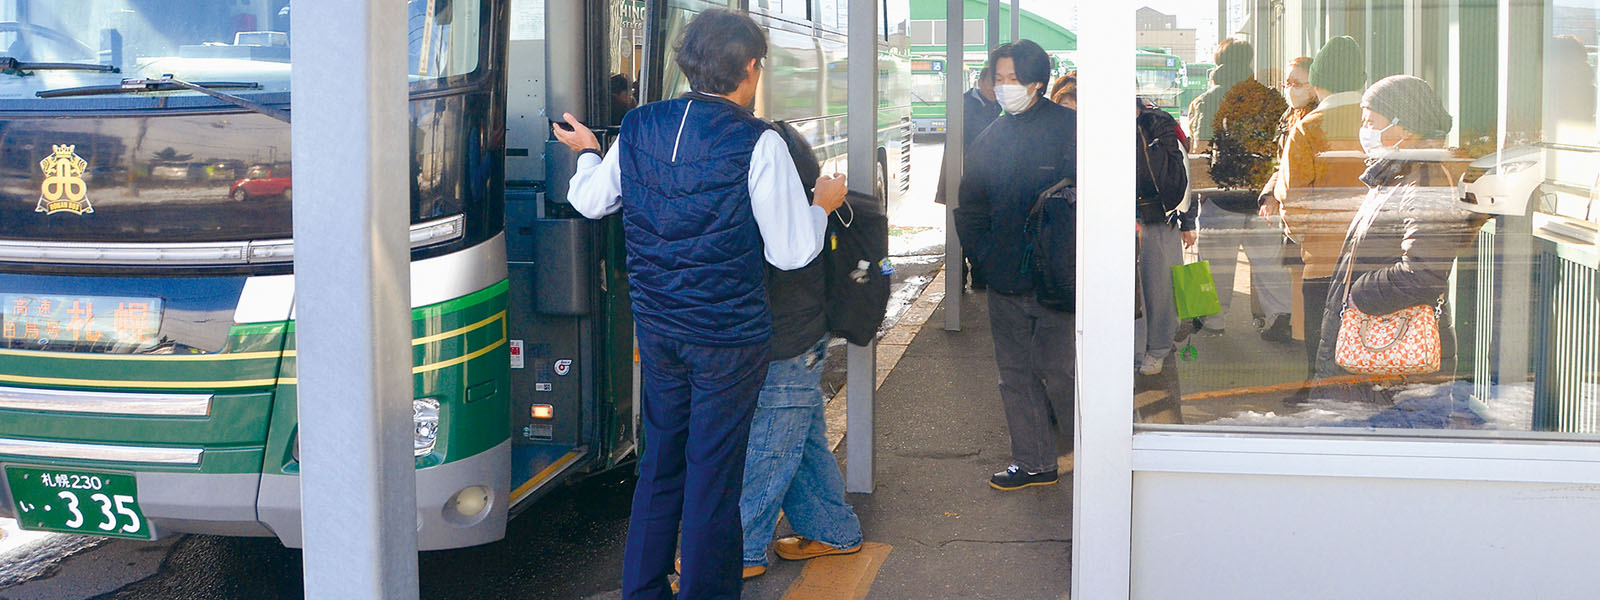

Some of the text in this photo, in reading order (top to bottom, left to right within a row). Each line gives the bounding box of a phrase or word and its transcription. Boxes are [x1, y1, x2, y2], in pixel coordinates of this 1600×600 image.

[13, 298, 53, 318] 高速
[66, 300, 151, 343] 札幌
[41, 473, 102, 490] 札幌230
